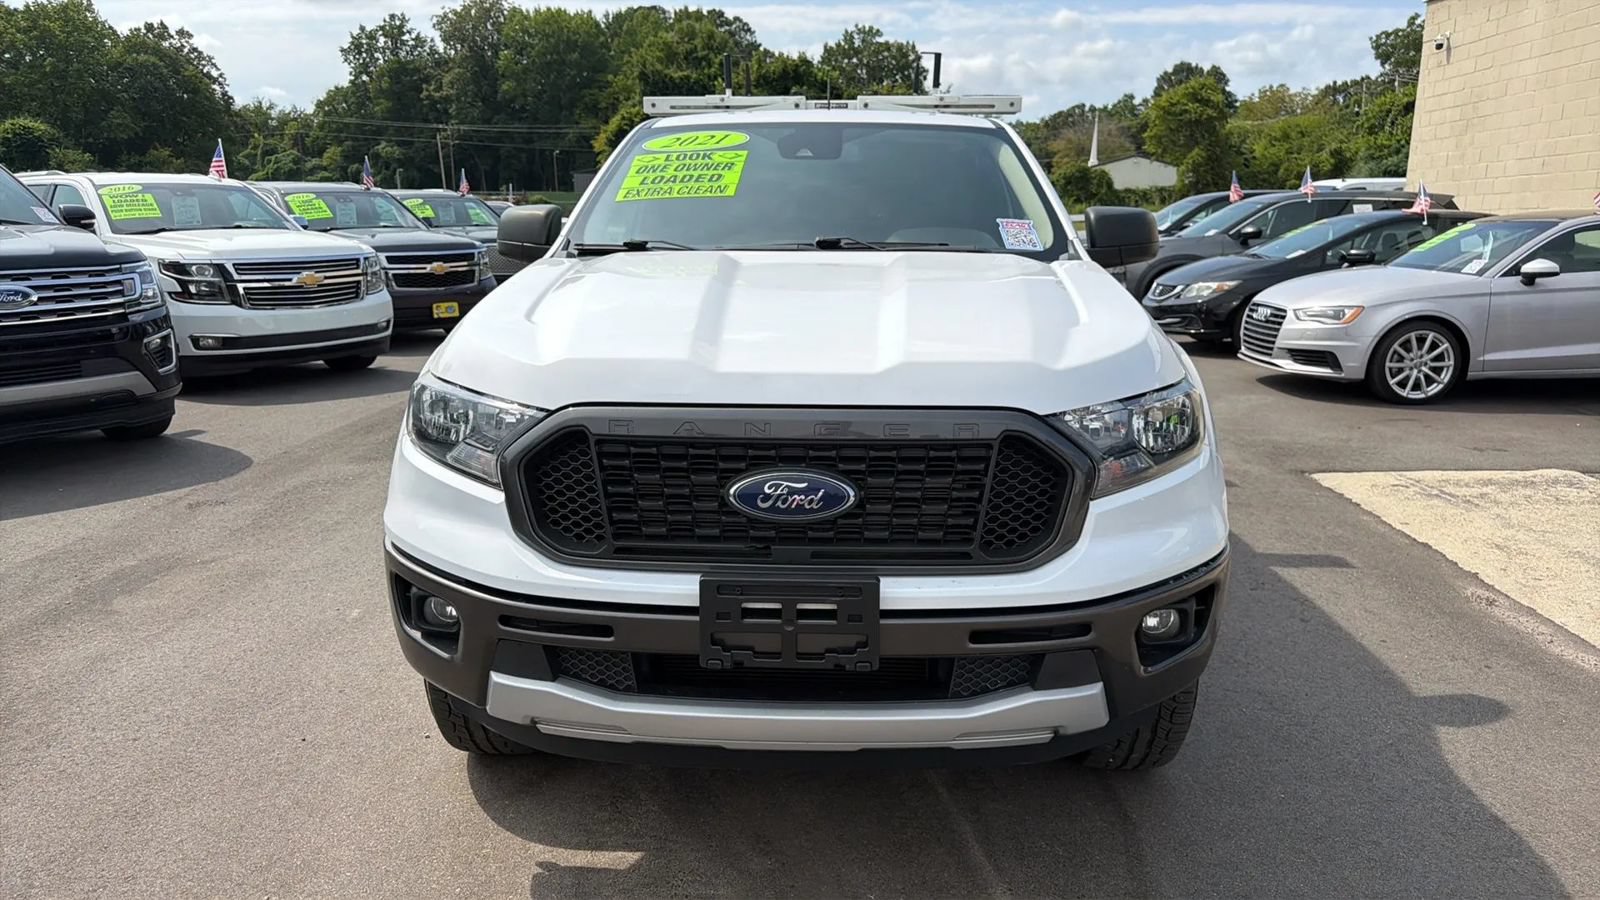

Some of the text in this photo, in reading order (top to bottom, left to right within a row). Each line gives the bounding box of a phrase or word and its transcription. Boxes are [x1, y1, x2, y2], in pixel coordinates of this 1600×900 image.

[661, 134, 731, 149] 2021
[664, 152, 713, 162] LOOK
[635, 162, 735, 174] ONE OWNER
[639, 173, 723, 186] LOADED
[623, 184, 728, 199] EXTRA CLEAN
[607, 419, 980, 438] RANGER
[757, 480, 825, 509] Ford
